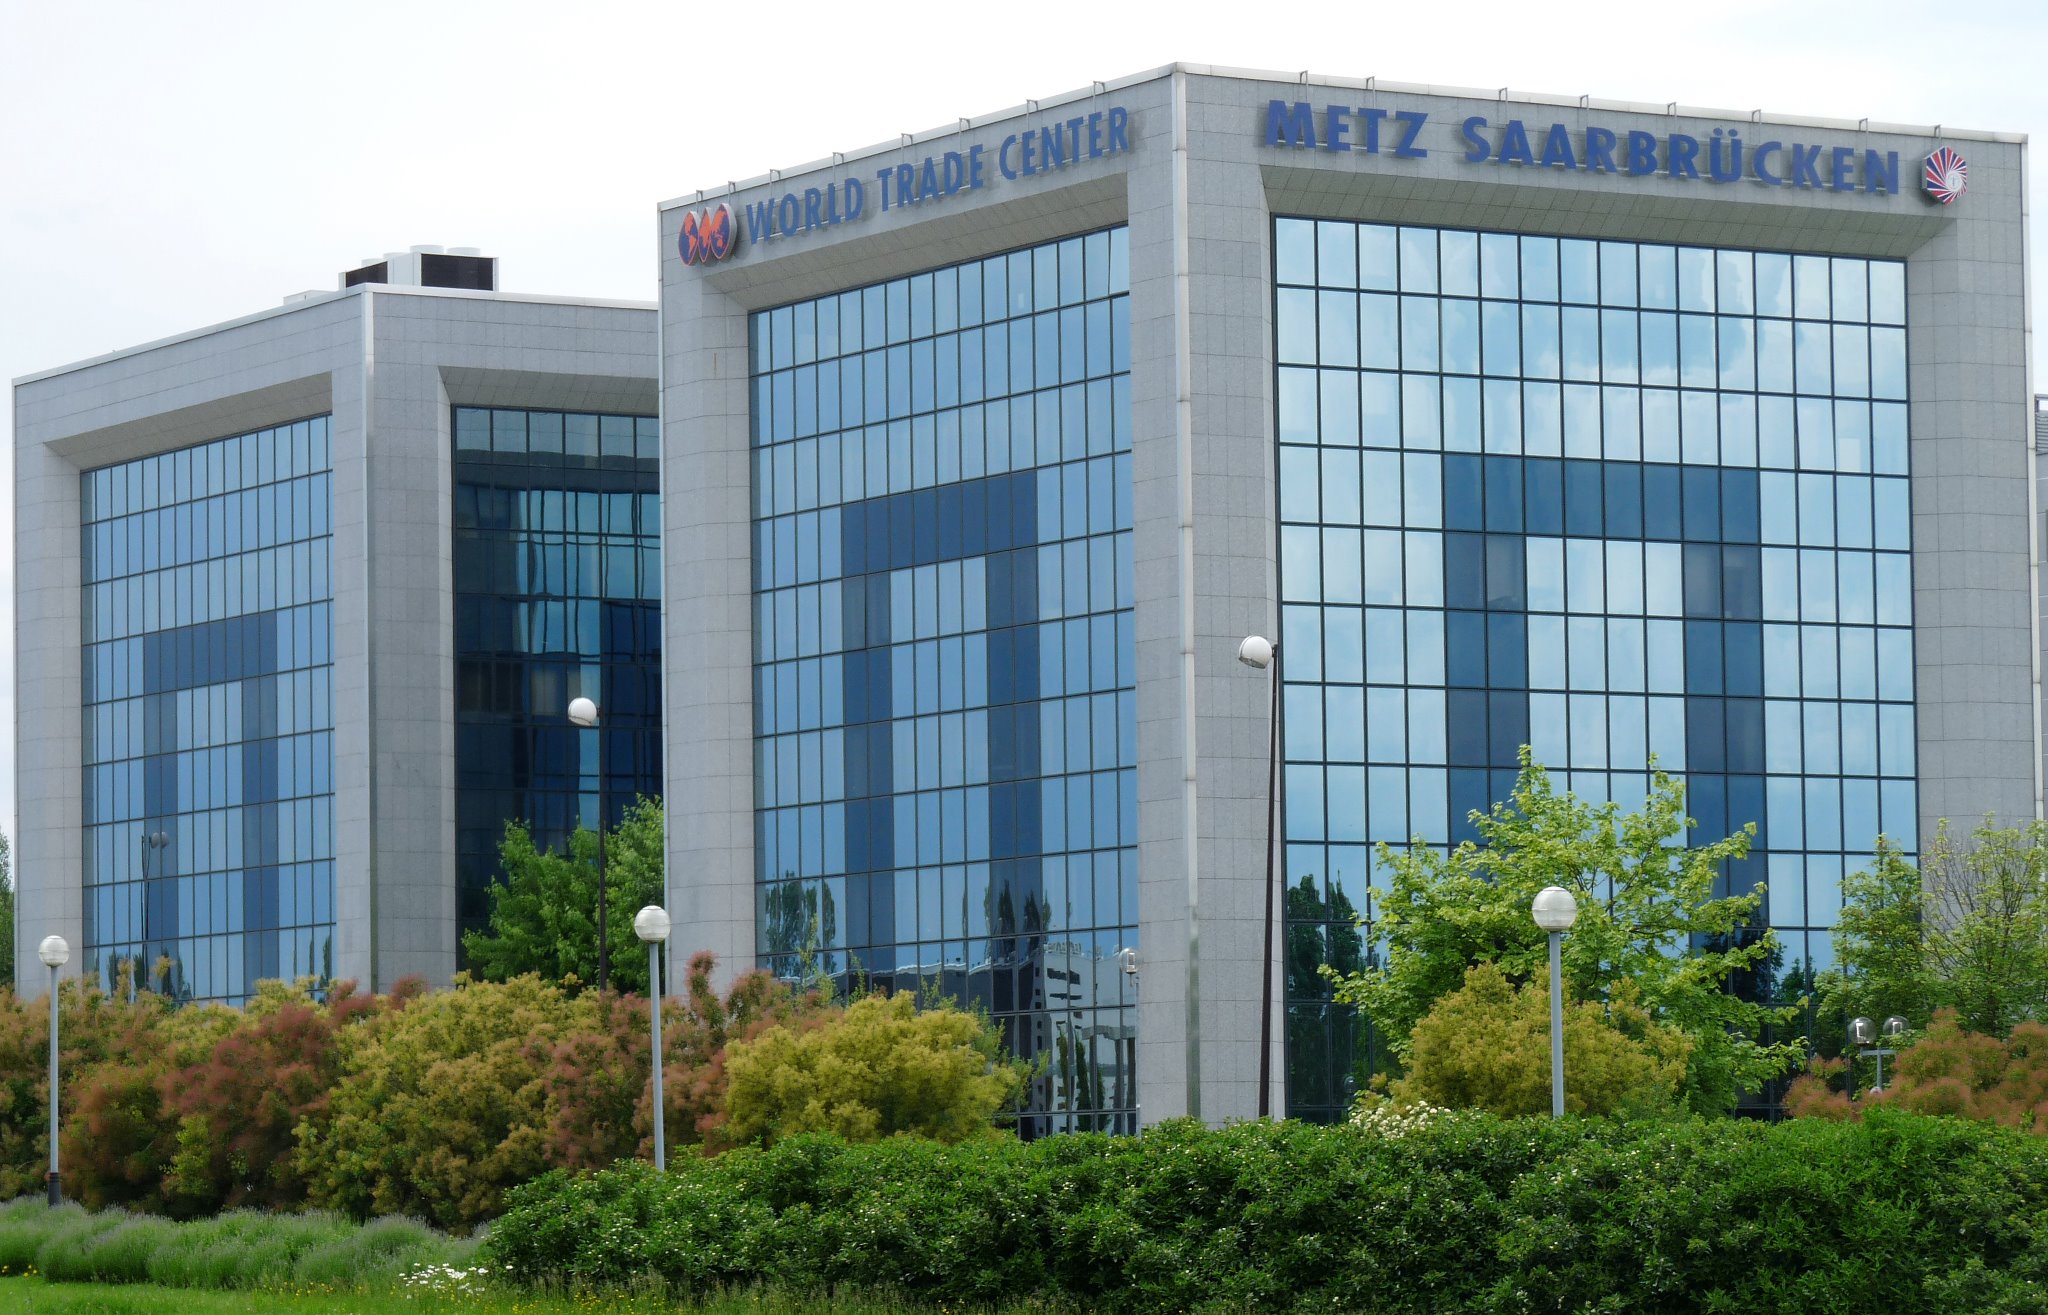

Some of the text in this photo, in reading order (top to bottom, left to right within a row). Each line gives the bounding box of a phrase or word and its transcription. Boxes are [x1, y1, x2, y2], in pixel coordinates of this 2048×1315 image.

[746, 107, 1128, 244] WORLD TRADE CENTER
[1265, 100, 1899, 194] METZ SAARBRÜCKEN
